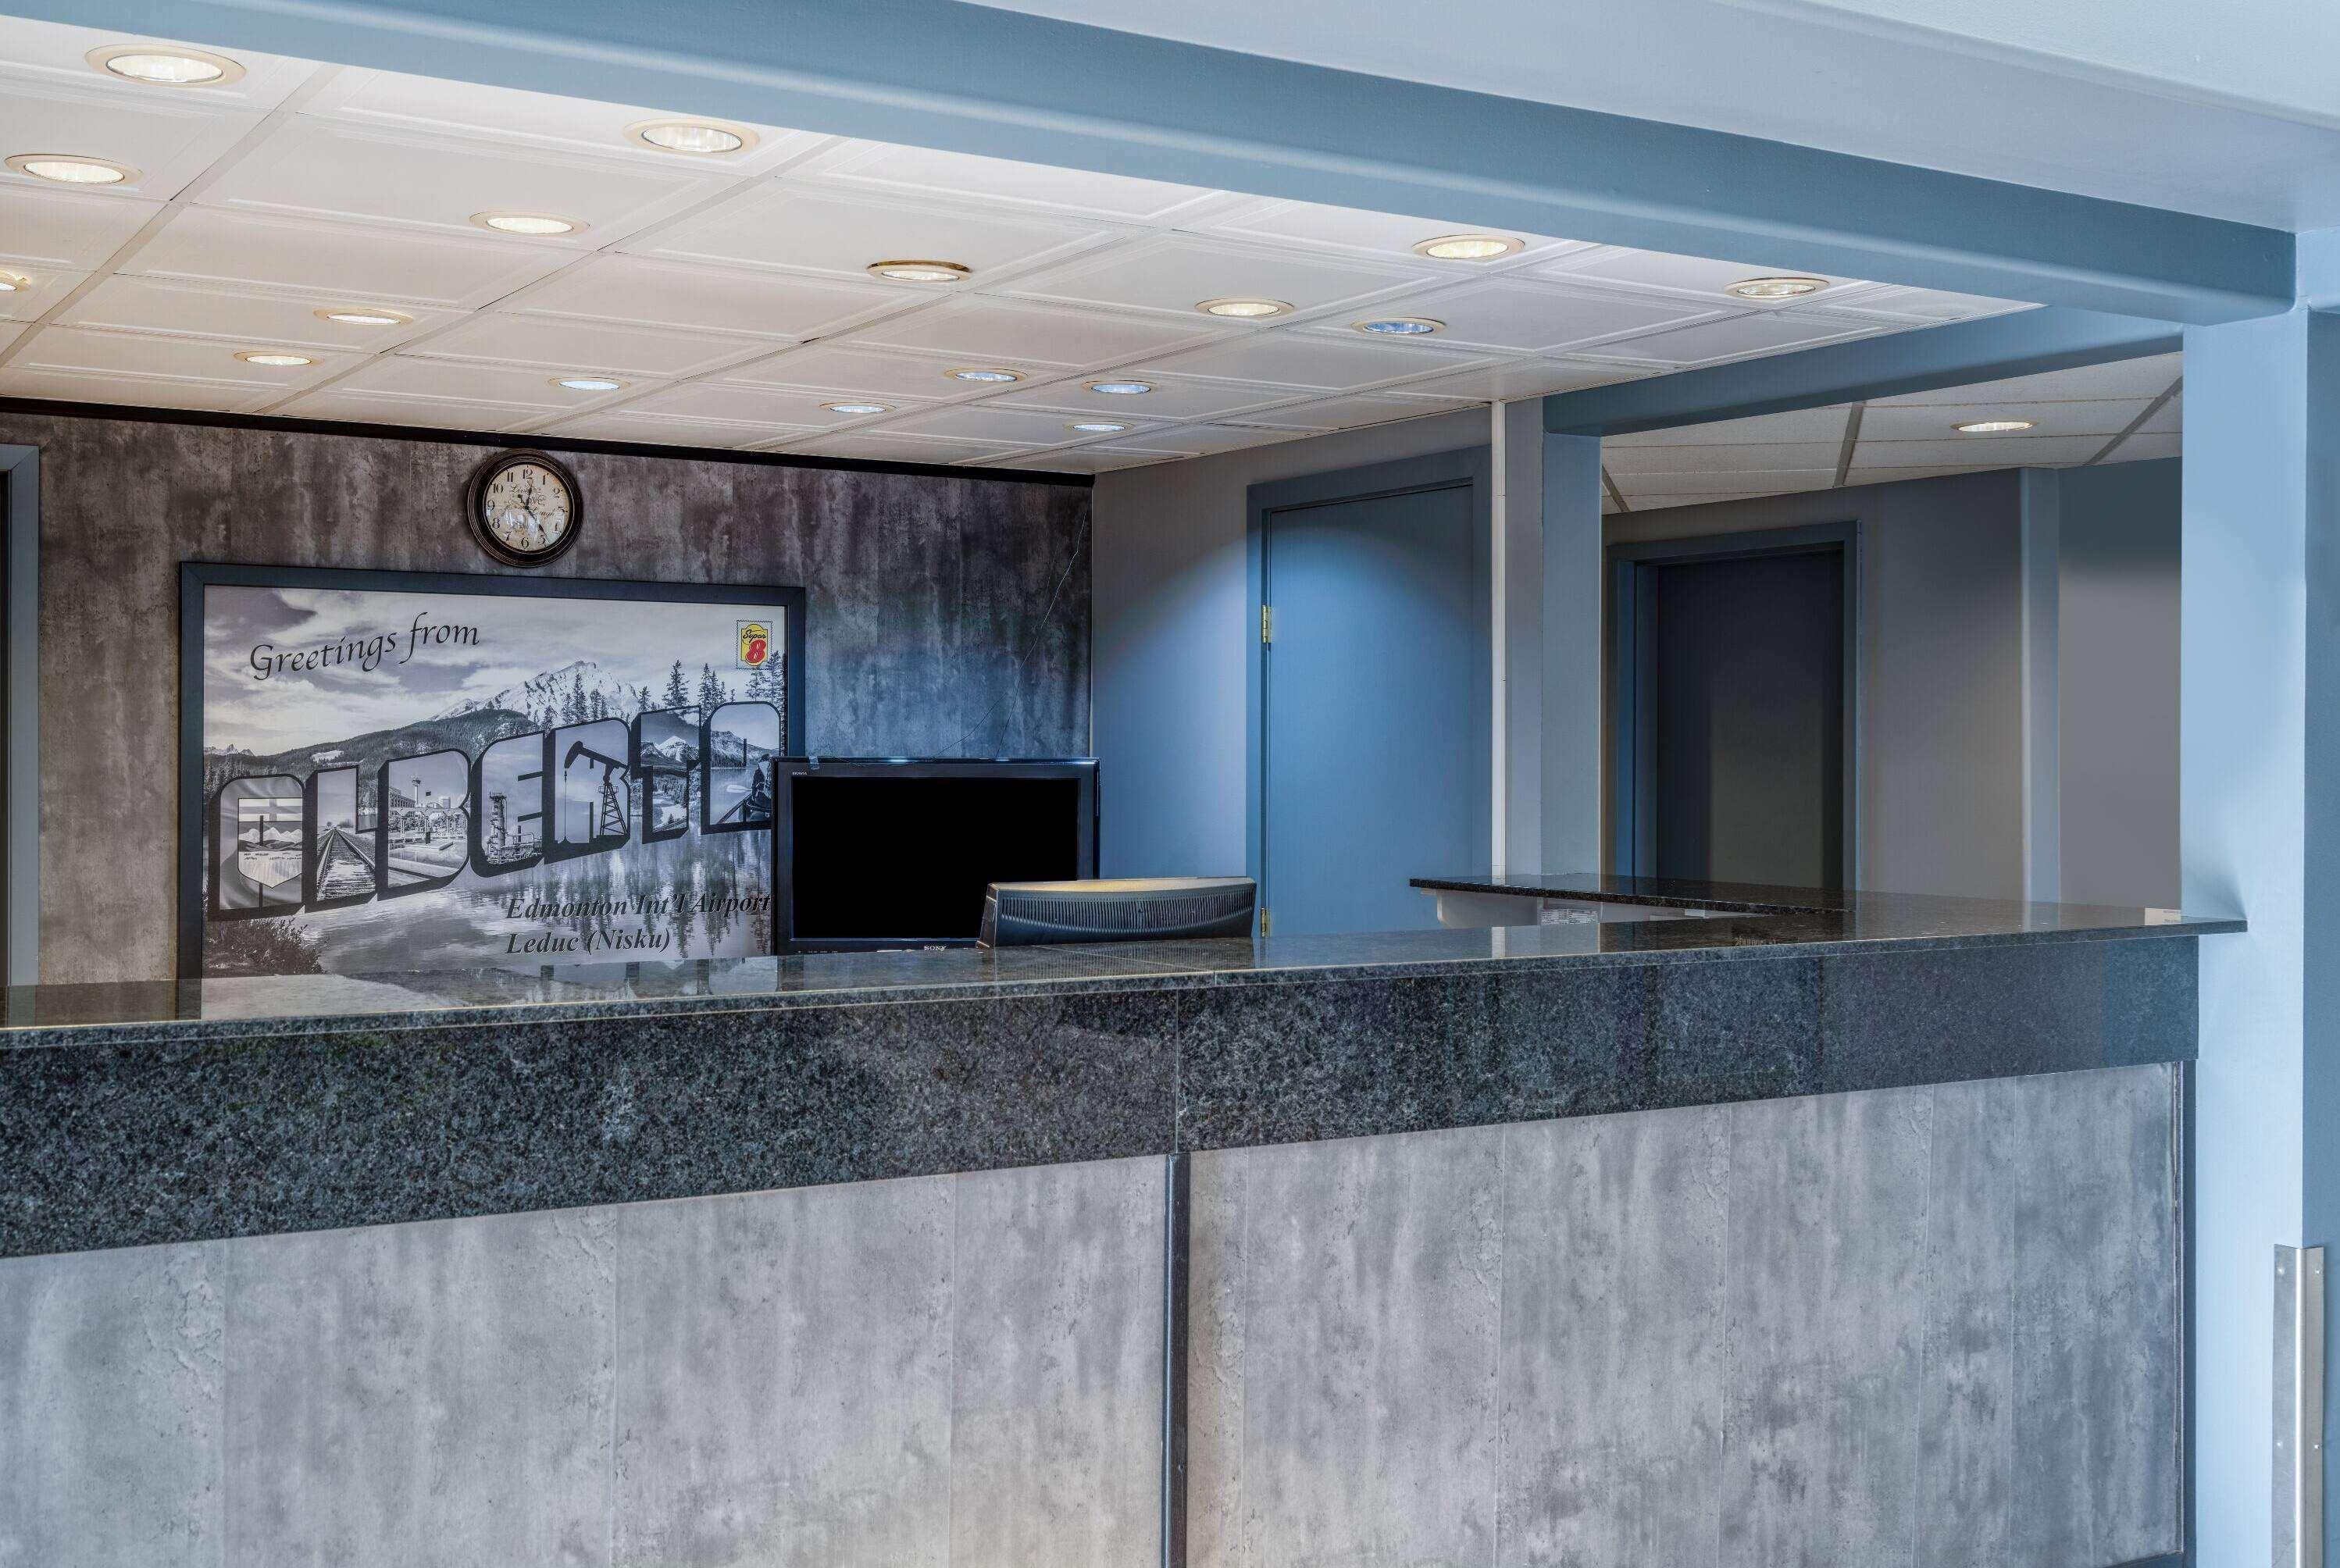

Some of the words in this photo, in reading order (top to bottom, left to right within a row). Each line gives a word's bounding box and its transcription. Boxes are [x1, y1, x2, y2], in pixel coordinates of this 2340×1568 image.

[507, 472, 514, 483] 11
[523, 469, 533, 479] 12
[542, 474, 546, 485] 1
[553, 488, 560, 499] 2
[487, 500, 495, 511] 9
[492, 518, 500, 529] 8
[505, 531, 512, 541] 7
[521, 537, 529, 548] 6
[742, 629, 766, 643] Super
[250, 631, 396, 680] Greetings
[398, 611, 480, 664] from
[745, 639, 766, 664] 8
[208, 701, 783, 921] ALBERTA
[506, 896, 627, 919] Edmonton
[692, 892, 771, 918] Airport
[505, 932, 579, 954] Leduc
[587, 928, 670, 956] (Nisku)
